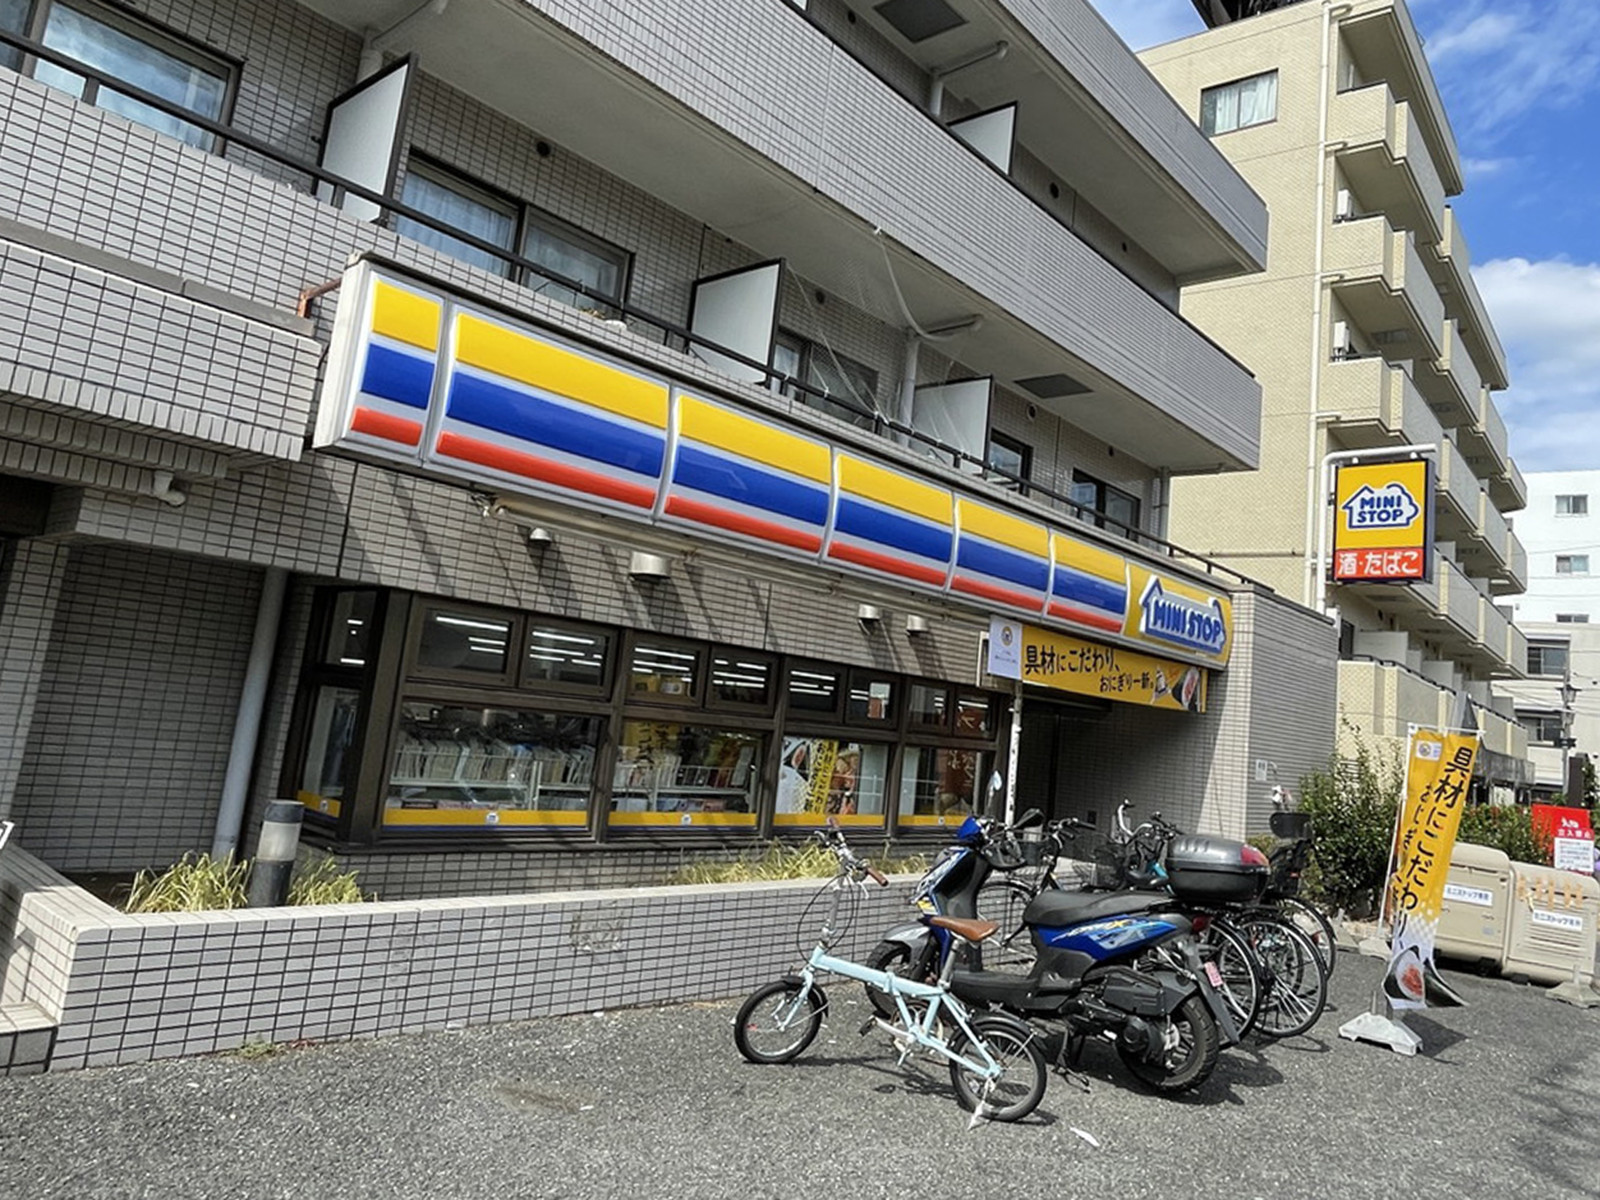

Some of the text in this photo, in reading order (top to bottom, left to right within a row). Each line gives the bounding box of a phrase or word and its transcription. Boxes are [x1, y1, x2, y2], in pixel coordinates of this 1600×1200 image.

[1360, 495, 1402, 509] MINI
[1357, 509, 1404, 523] STOP
[1152, 599, 1222, 644] MINI STOP
[1024, 644, 1121, 676] 具材にこだわり、
